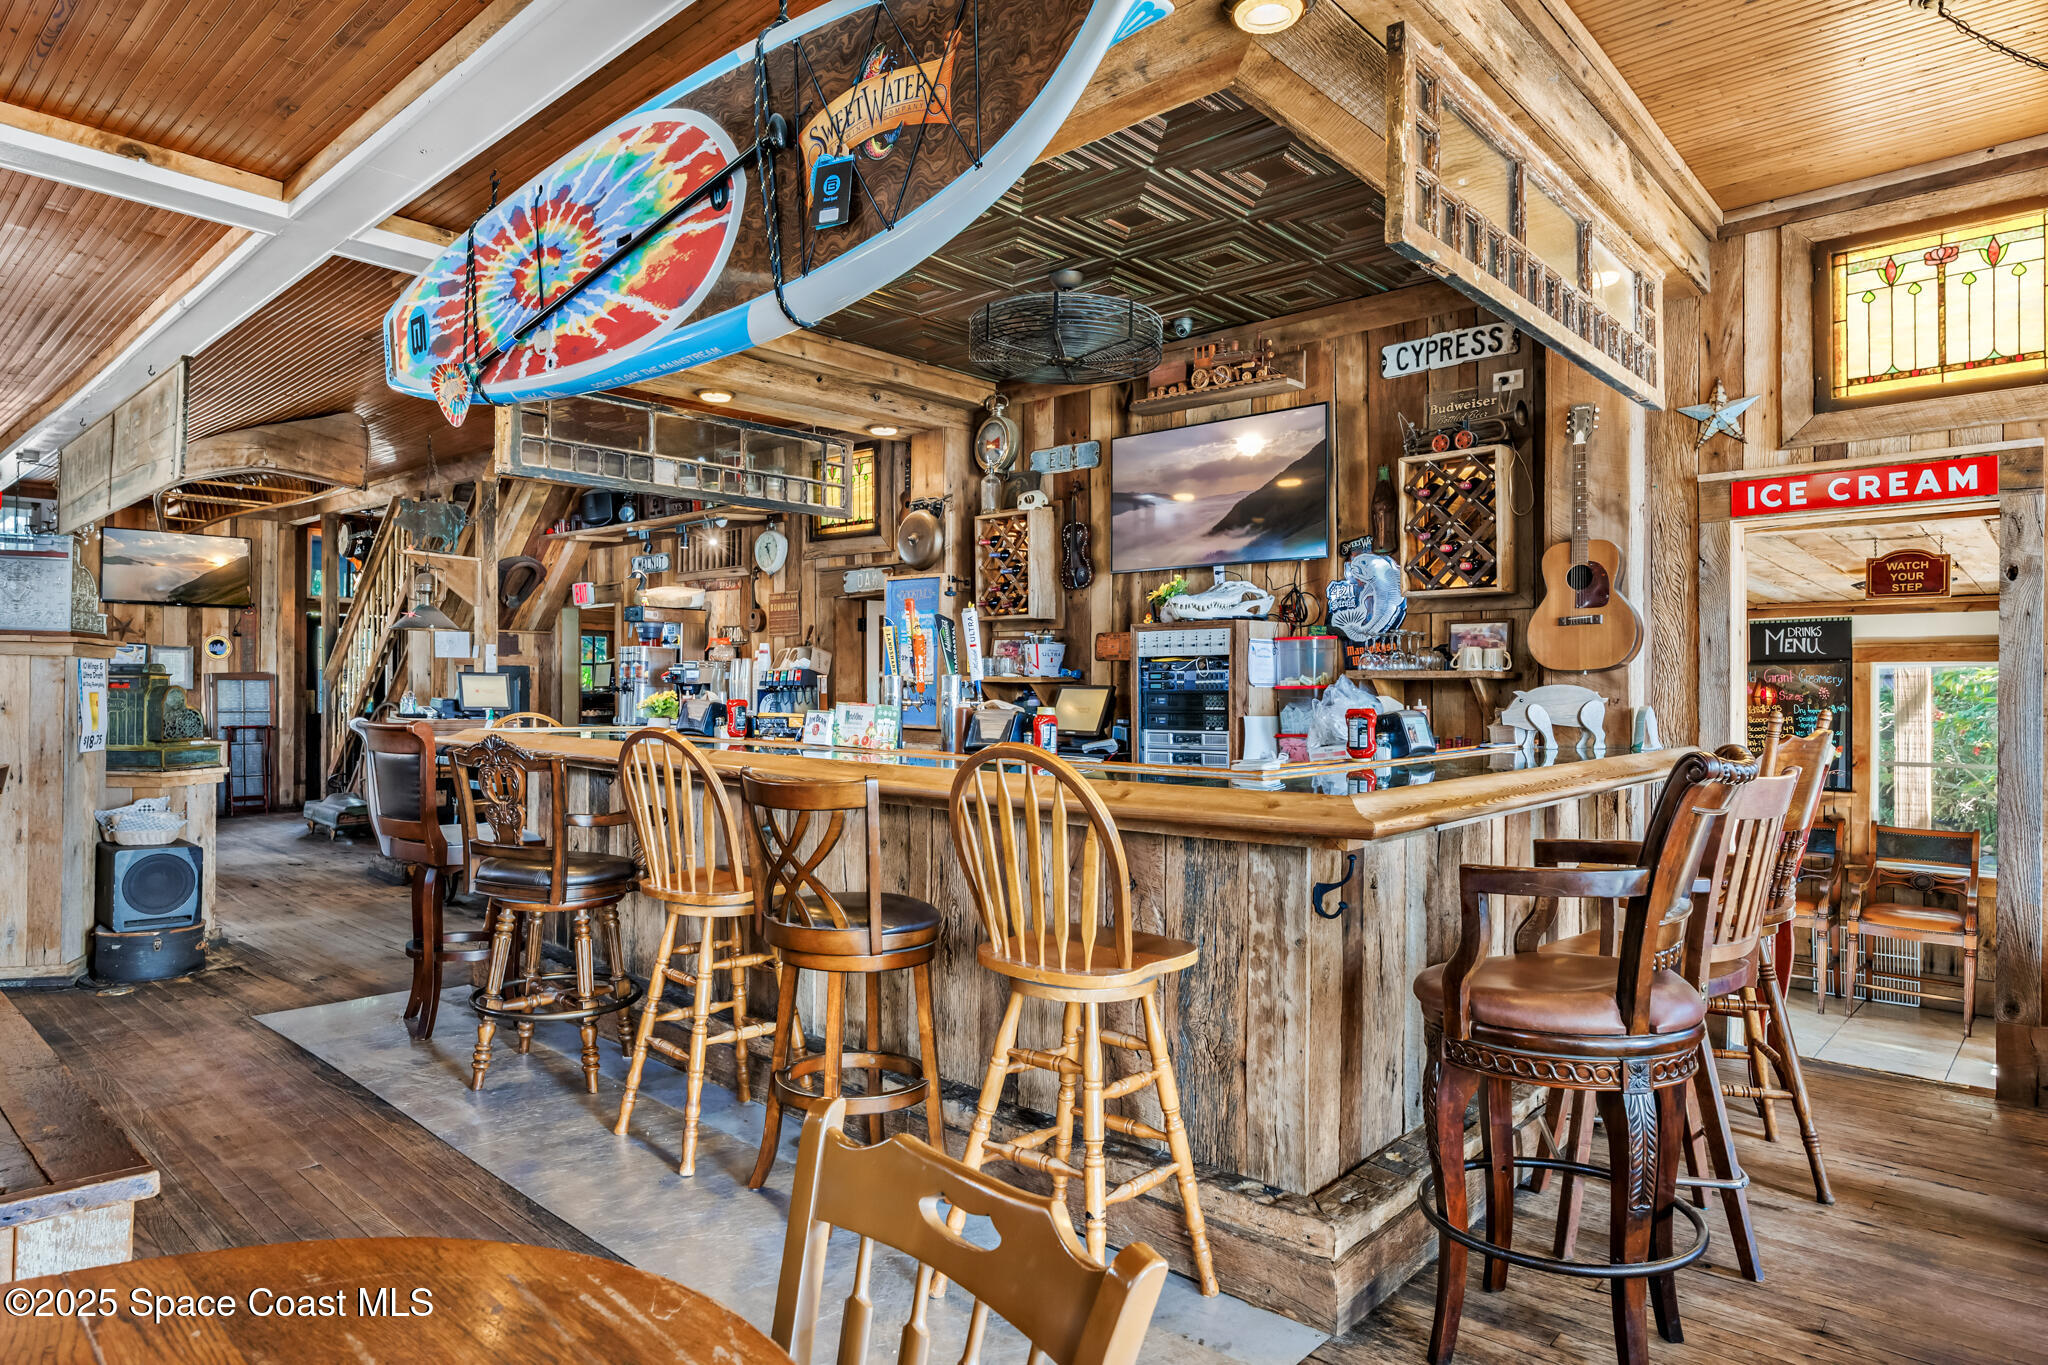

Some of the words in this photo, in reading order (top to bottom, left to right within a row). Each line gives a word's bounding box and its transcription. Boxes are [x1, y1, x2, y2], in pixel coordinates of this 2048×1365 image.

[883, 102, 925, 118] COMPANY
[1396, 326, 1504, 371] CYPRESS
[617, 369, 642, 384] FLOAT
[641, 363, 660, 376] THE
[659, 346, 723, 371] MAINSTREAM
[1430, 397, 1498, 415] Budweiser
[1049, 445, 1079, 470] ELM
[1747, 481, 1807, 509] ICE
[1827, 464, 1979, 501] CREAM
[1886, 560, 1929, 571] WATCH
[1890, 571, 1925, 582] YOUR
[574, 583, 588, 604] EXIT
[1891, 582, 1923, 592] STEP
[770, 602, 797, 612] BOUNDARY
[968, 615, 977, 643] ULTRA
[1787, 626, 1823, 637] DRINKS
[951, 625, 959, 674] TRACOASTAL
[1765, 629, 1828, 656] MENU
[1798, 668, 1844, 687] Creamery
[1778, 690, 1804, 702] Sizes
[1793, 704, 1807, 715] Dry
[83, 734, 103, 750] $18.75
